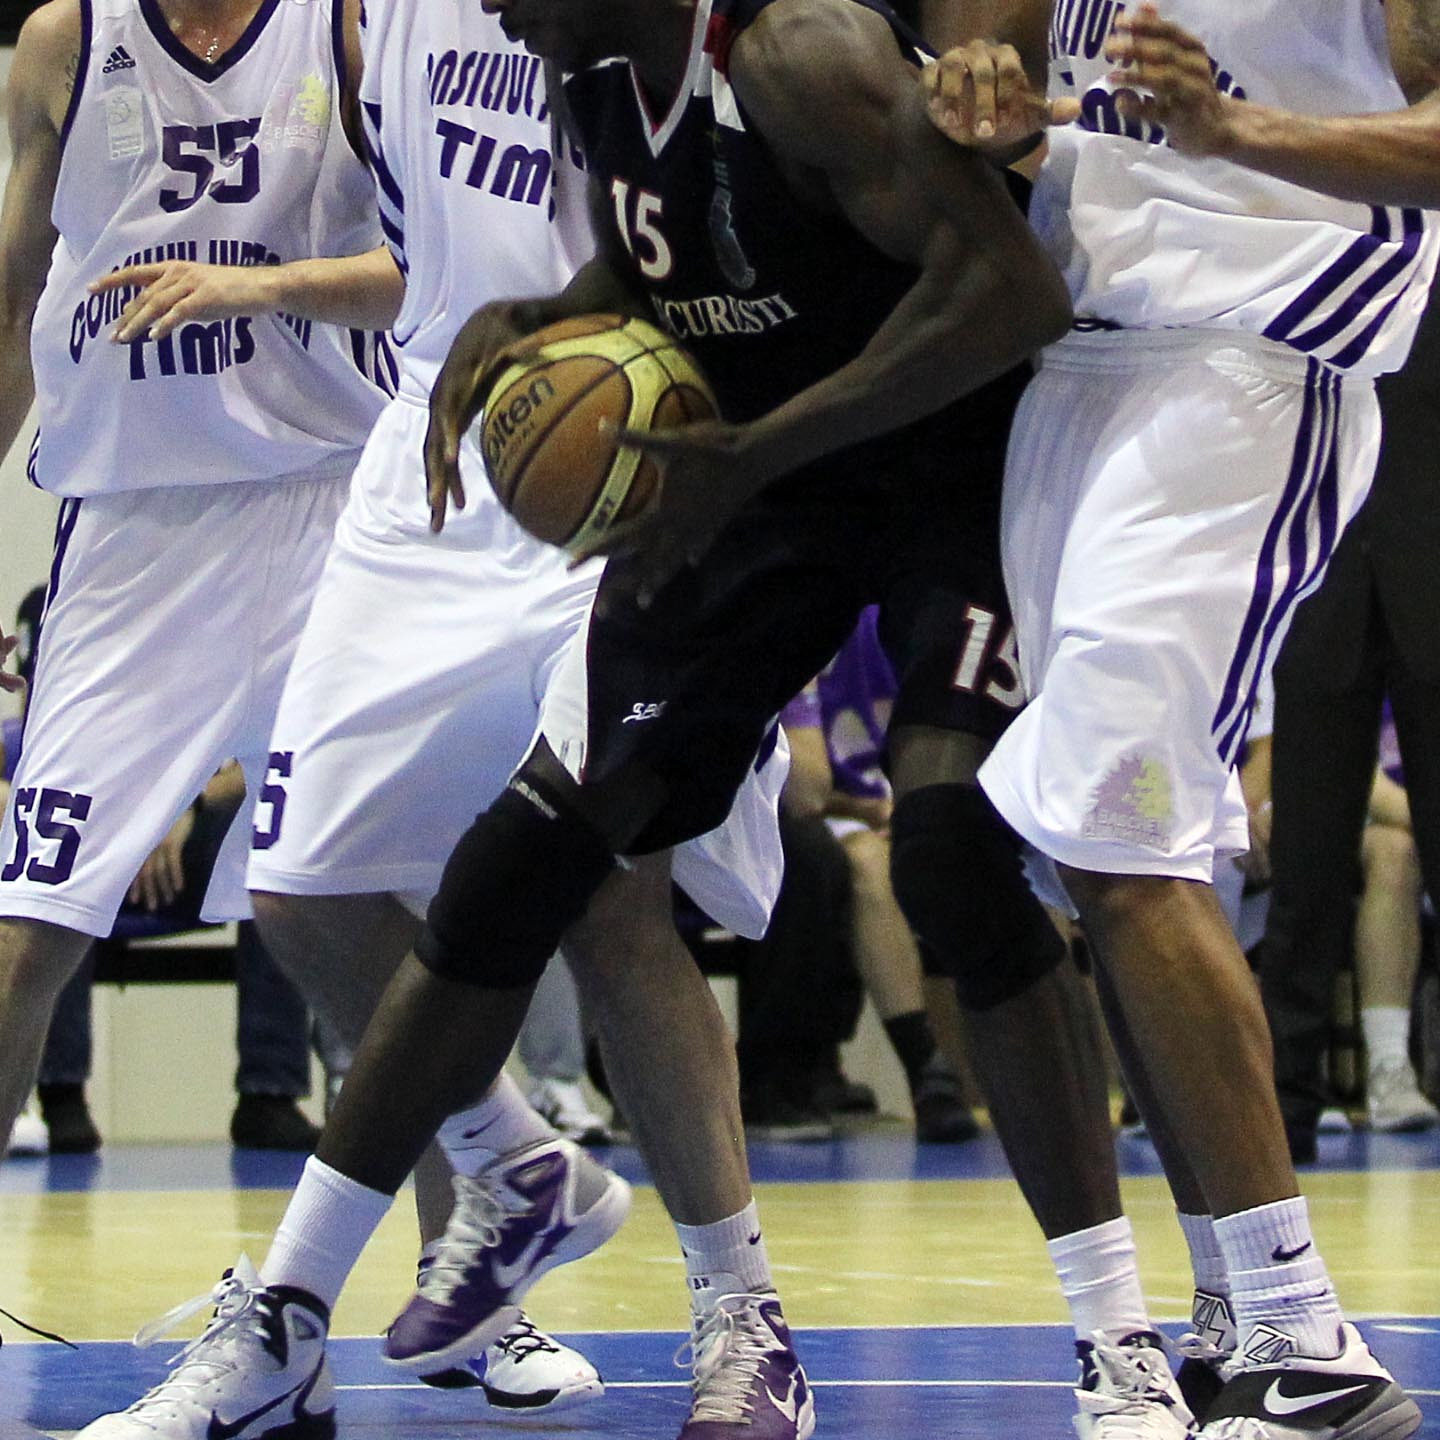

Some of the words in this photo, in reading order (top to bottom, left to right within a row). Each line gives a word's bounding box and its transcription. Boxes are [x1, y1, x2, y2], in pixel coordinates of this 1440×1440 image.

[158, 116, 262, 213] 55
[612, 177, 673, 280] 15
[486, 376, 556, 466] olten
[1, 787, 94, 886] 55
